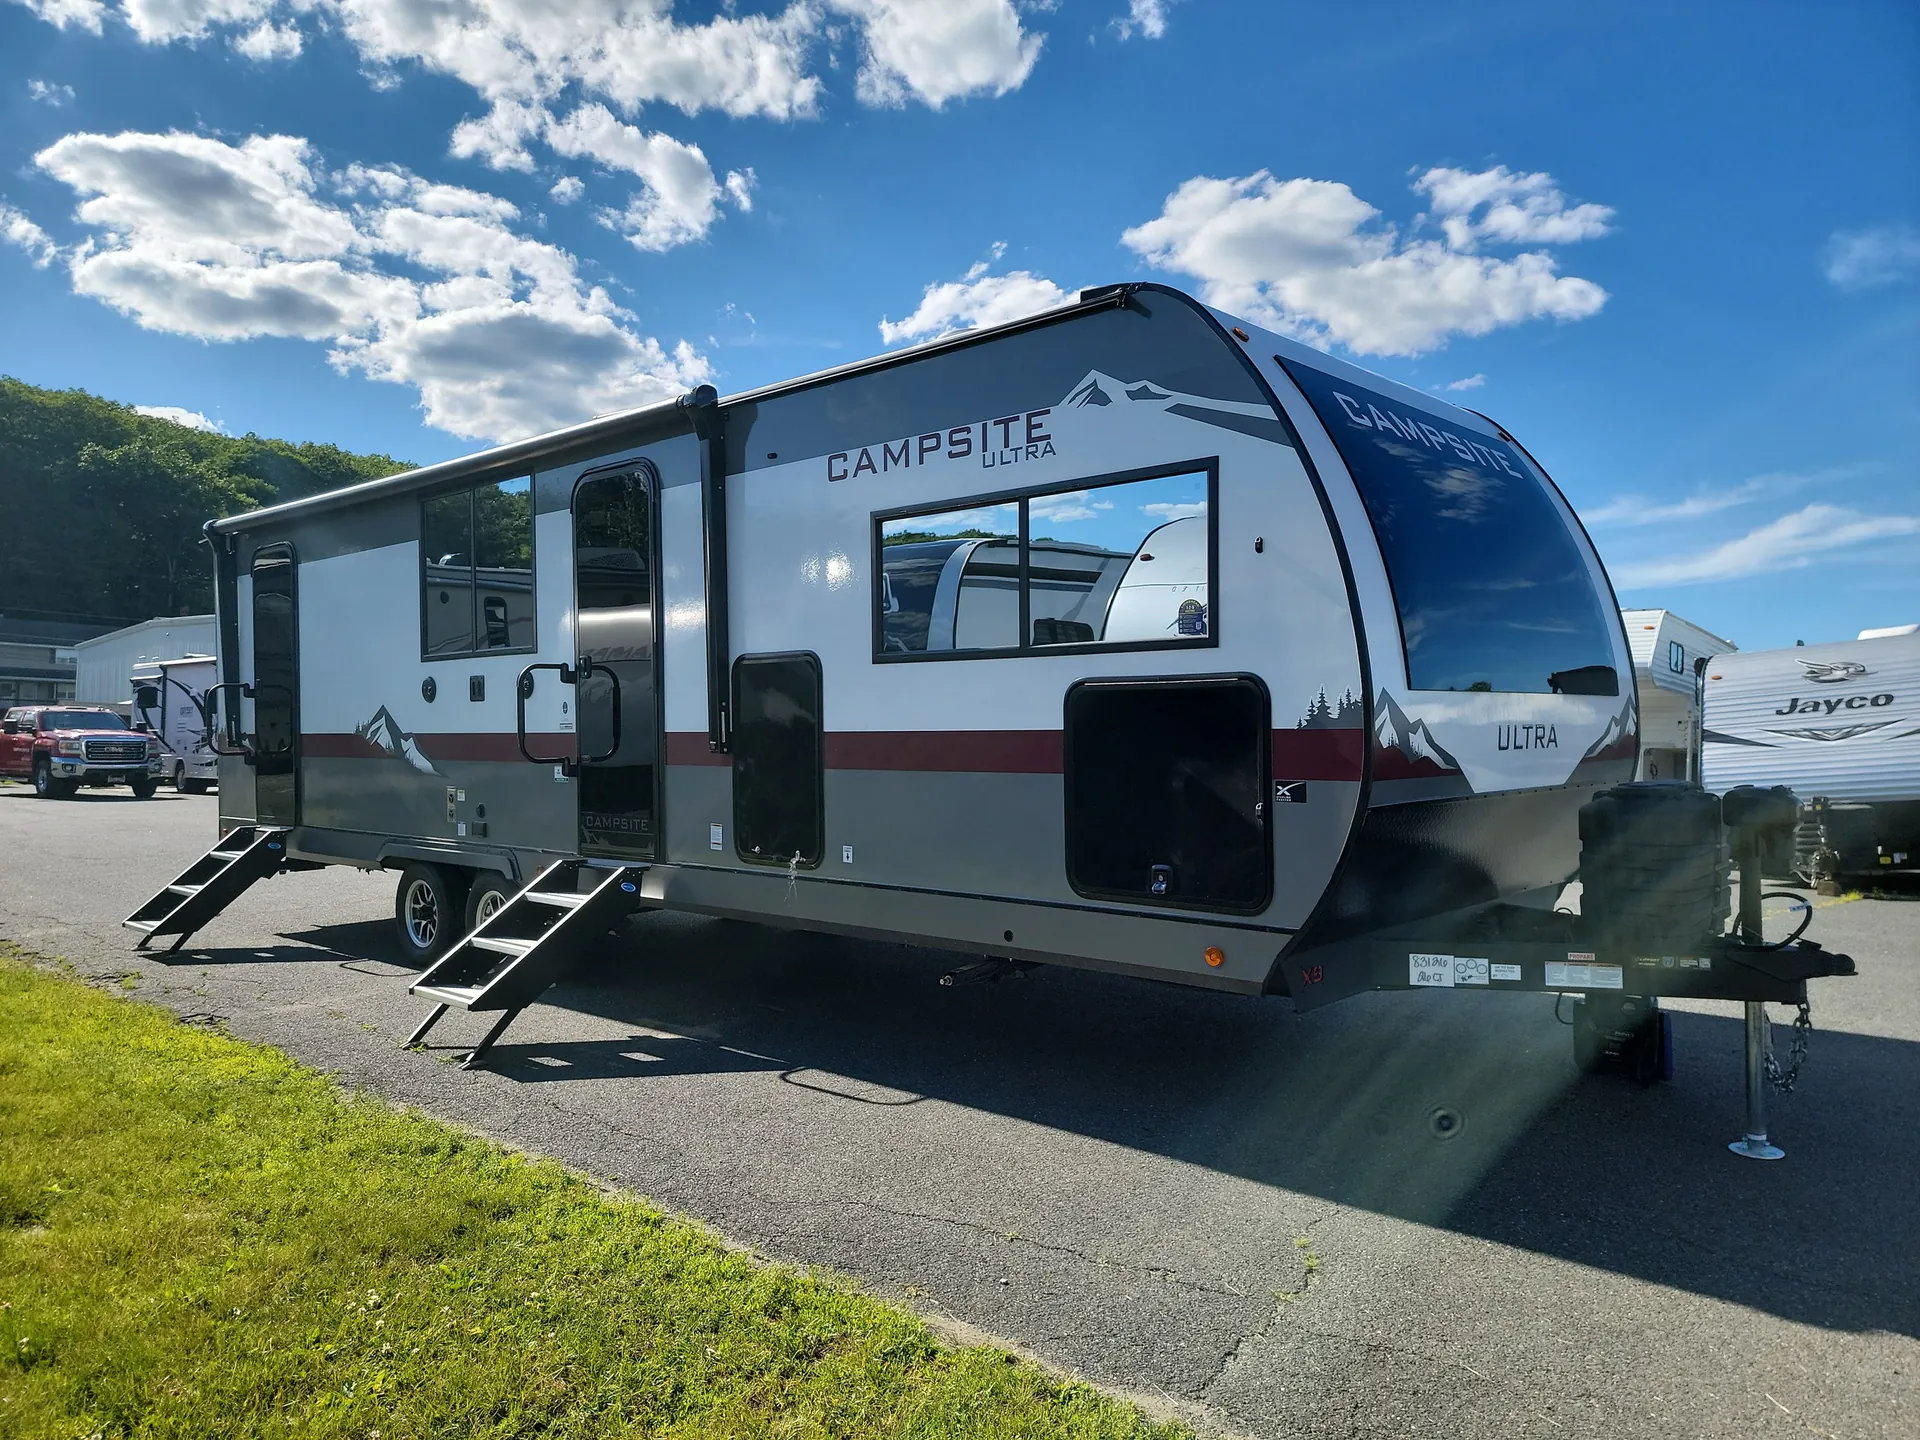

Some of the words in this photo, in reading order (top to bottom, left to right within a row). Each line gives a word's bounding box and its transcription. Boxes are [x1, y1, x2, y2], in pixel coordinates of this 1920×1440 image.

[827, 408, 1051, 482] CAMPSITE
[1332, 391, 1524, 480] CAMPSITE
[981, 440, 1057, 468] ULTRA
[1775, 693, 1895, 715] Jayco
[1497, 723, 1559, 751] ULTRA
[586, 816, 649, 831] CAMPSITE
